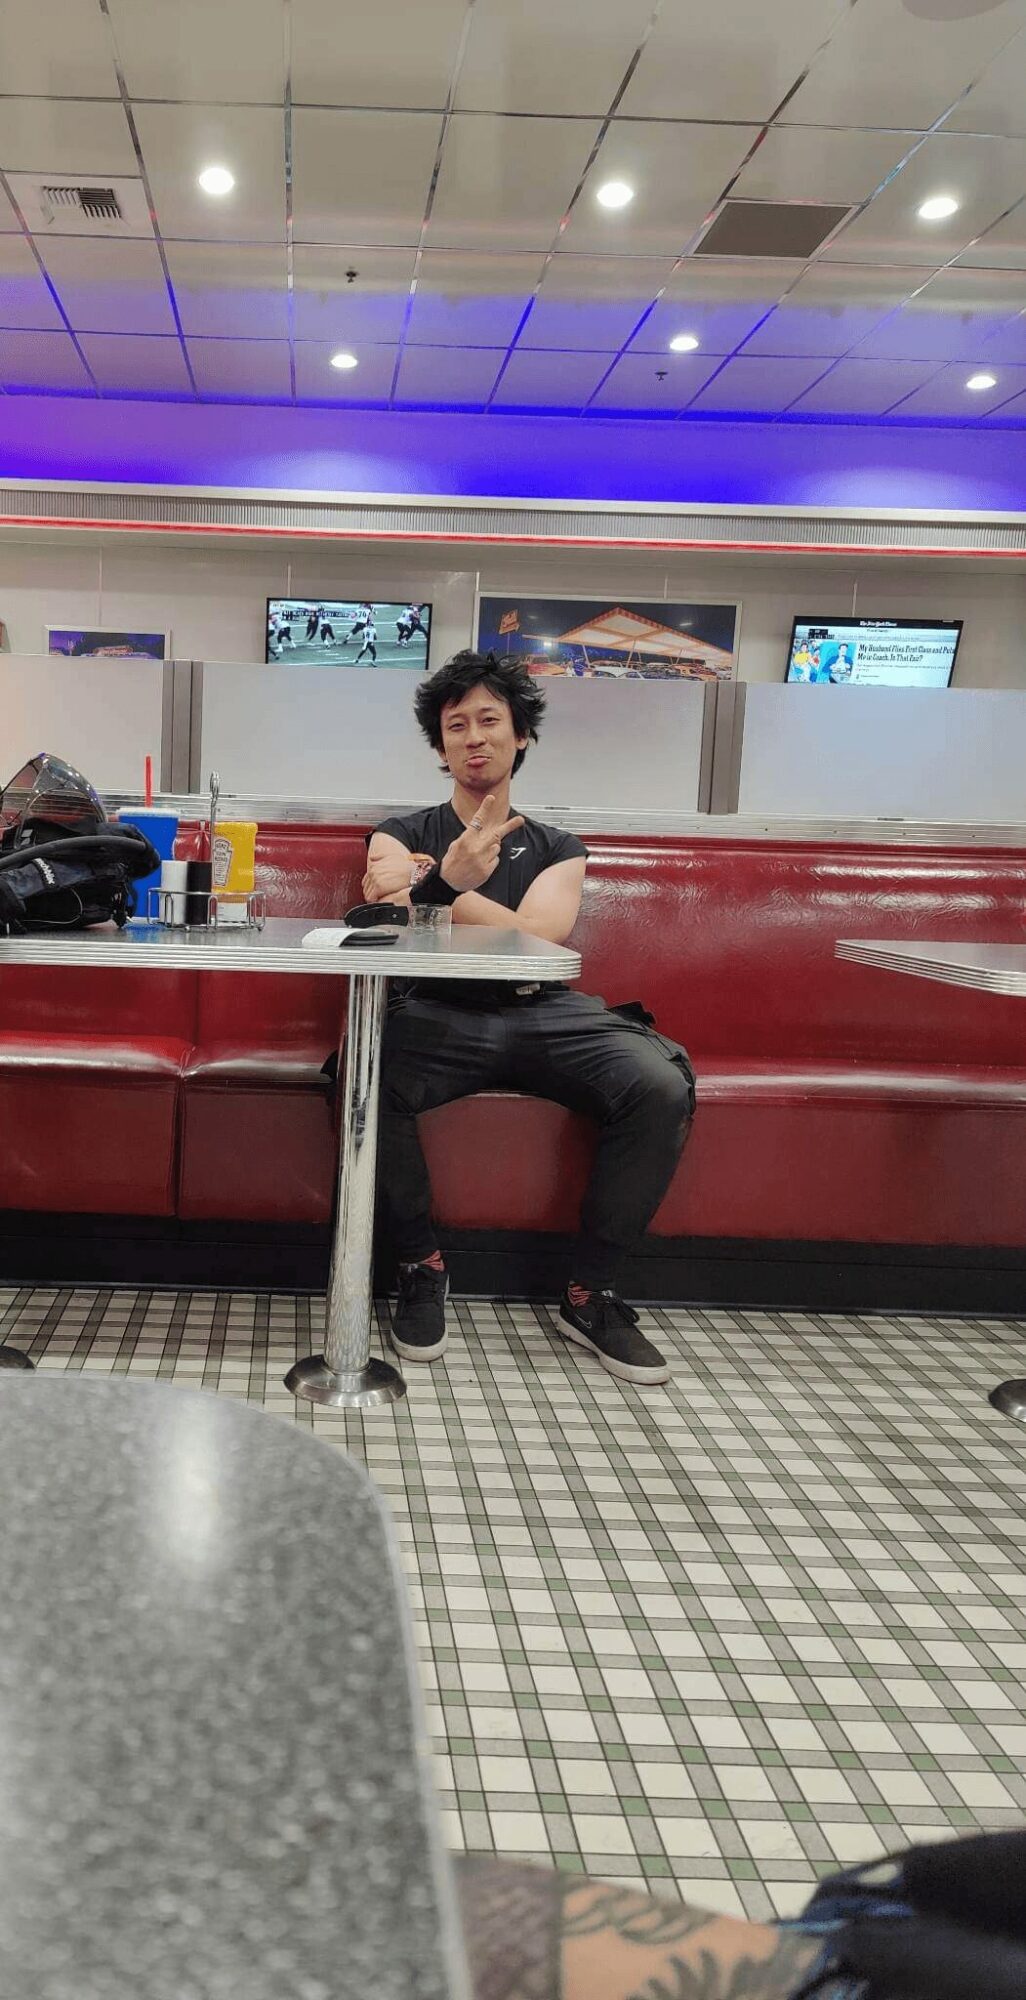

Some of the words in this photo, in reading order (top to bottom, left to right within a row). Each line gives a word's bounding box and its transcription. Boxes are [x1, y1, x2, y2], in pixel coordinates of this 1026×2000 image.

[859, 644, 867, 653] My
[868, 644, 891, 652] Husband
[891, 645, 904, 653] Flies
[905, 645, 918, 653] First
[932, 646, 942, 654] and
